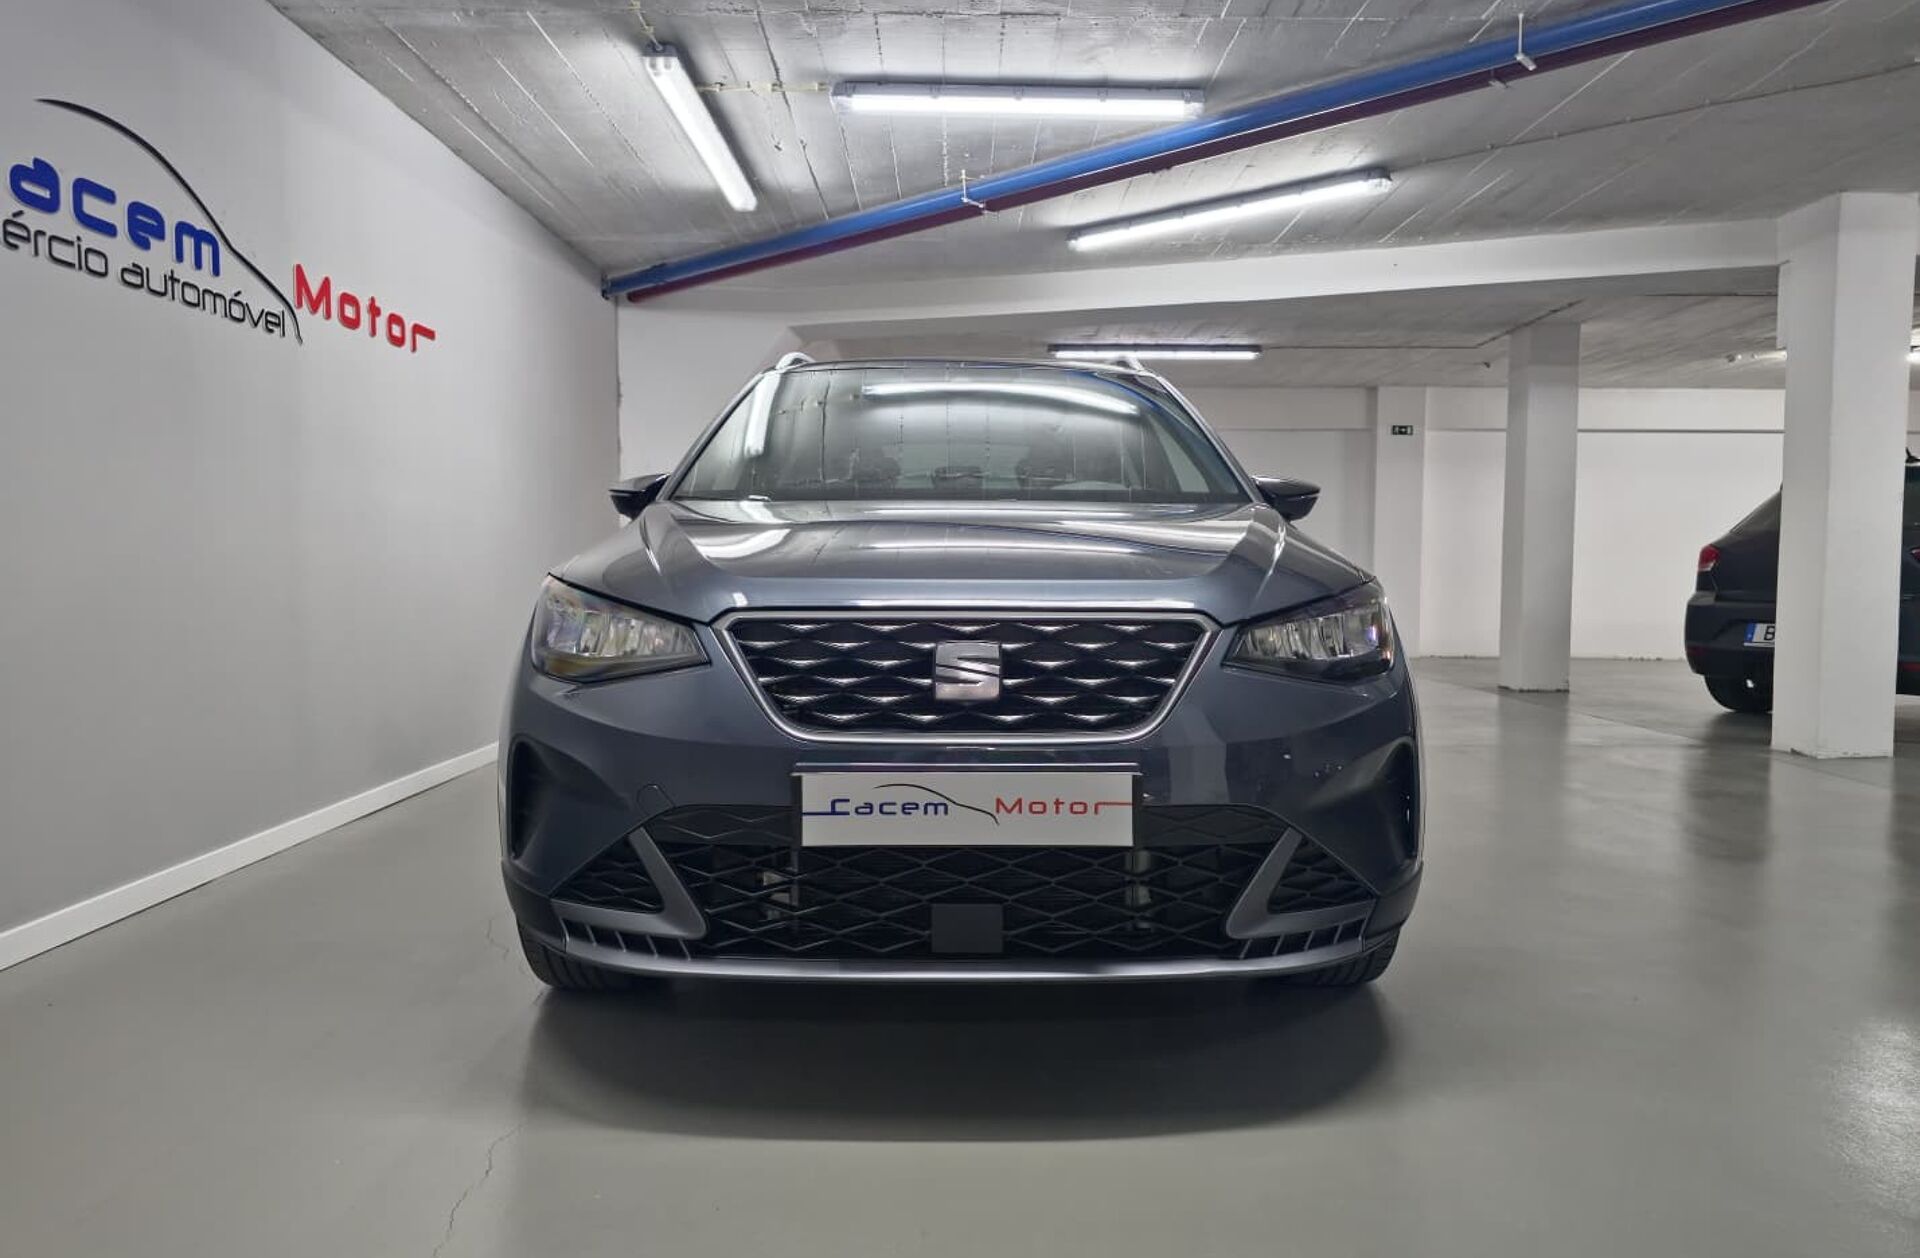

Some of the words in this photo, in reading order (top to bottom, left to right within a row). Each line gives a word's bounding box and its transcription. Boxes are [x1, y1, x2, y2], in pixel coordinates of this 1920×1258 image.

[2, 209, 109, 278] ércio
[119, 261, 287, 338] automóvel
[292, 263, 436, 353] Motor
[803, 798, 949, 816] Cacem
[995, 797, 1132, 816] Motor
